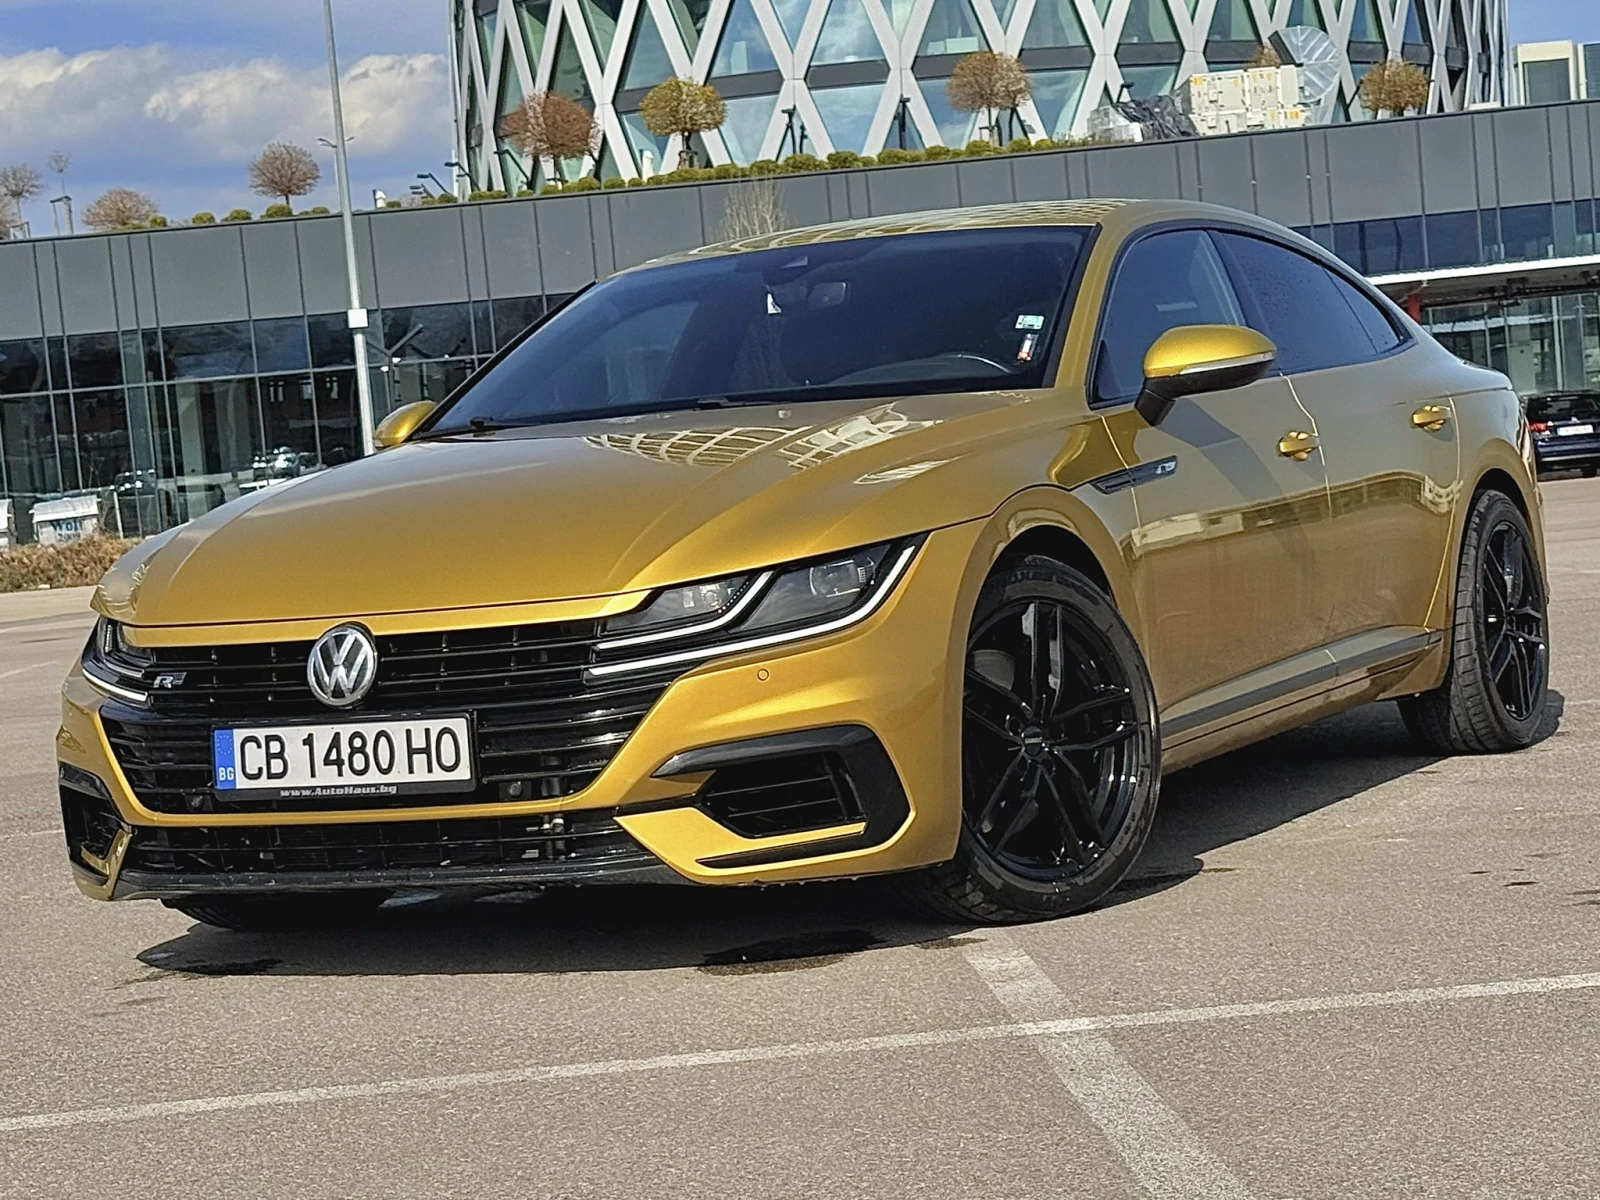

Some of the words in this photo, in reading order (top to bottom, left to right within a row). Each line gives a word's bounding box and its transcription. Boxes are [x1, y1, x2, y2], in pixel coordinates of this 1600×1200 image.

[240, 734, 289, 780] CB
[302, 729, 395, 778] 1480
[405, 726, 461, 774] HO
[218, 767, 234, 781] BG
[280, 784, 398, 797] www.AutoHaus.bg
